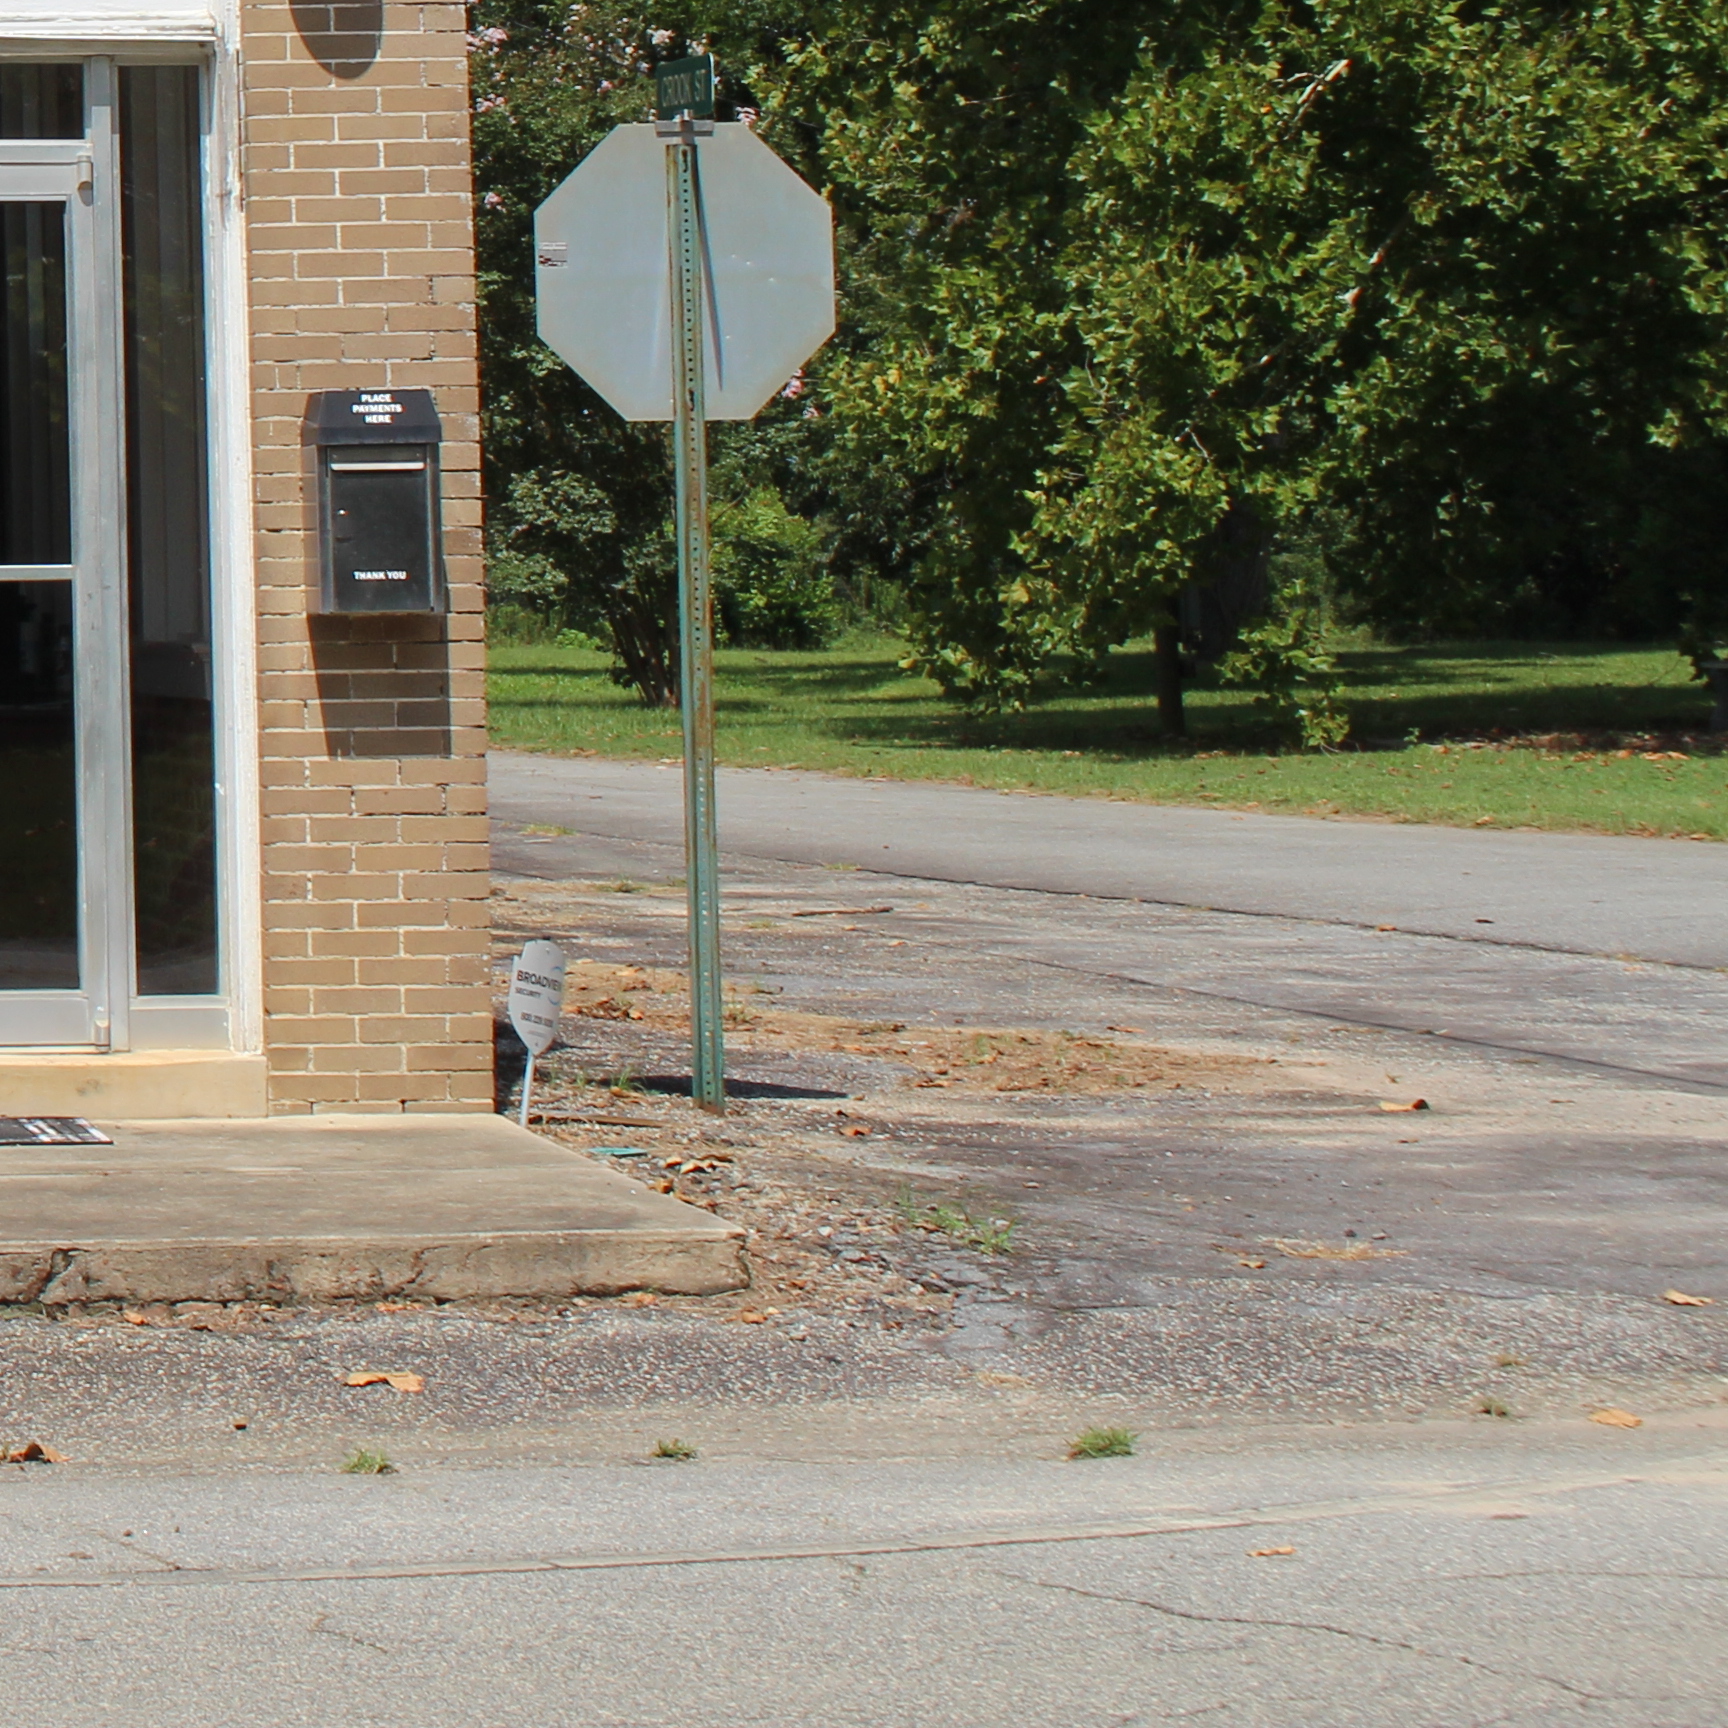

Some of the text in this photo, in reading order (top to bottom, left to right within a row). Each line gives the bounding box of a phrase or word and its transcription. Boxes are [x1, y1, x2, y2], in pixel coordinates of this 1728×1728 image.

[694, 69, 707, 102] ST
[360, 393, 393, 403] PLACE
[351, 403, 404, 414] PAYMENTS
[364, 414, 393, 424] HERE
[353, 570, 408, 580] THANK YOU
